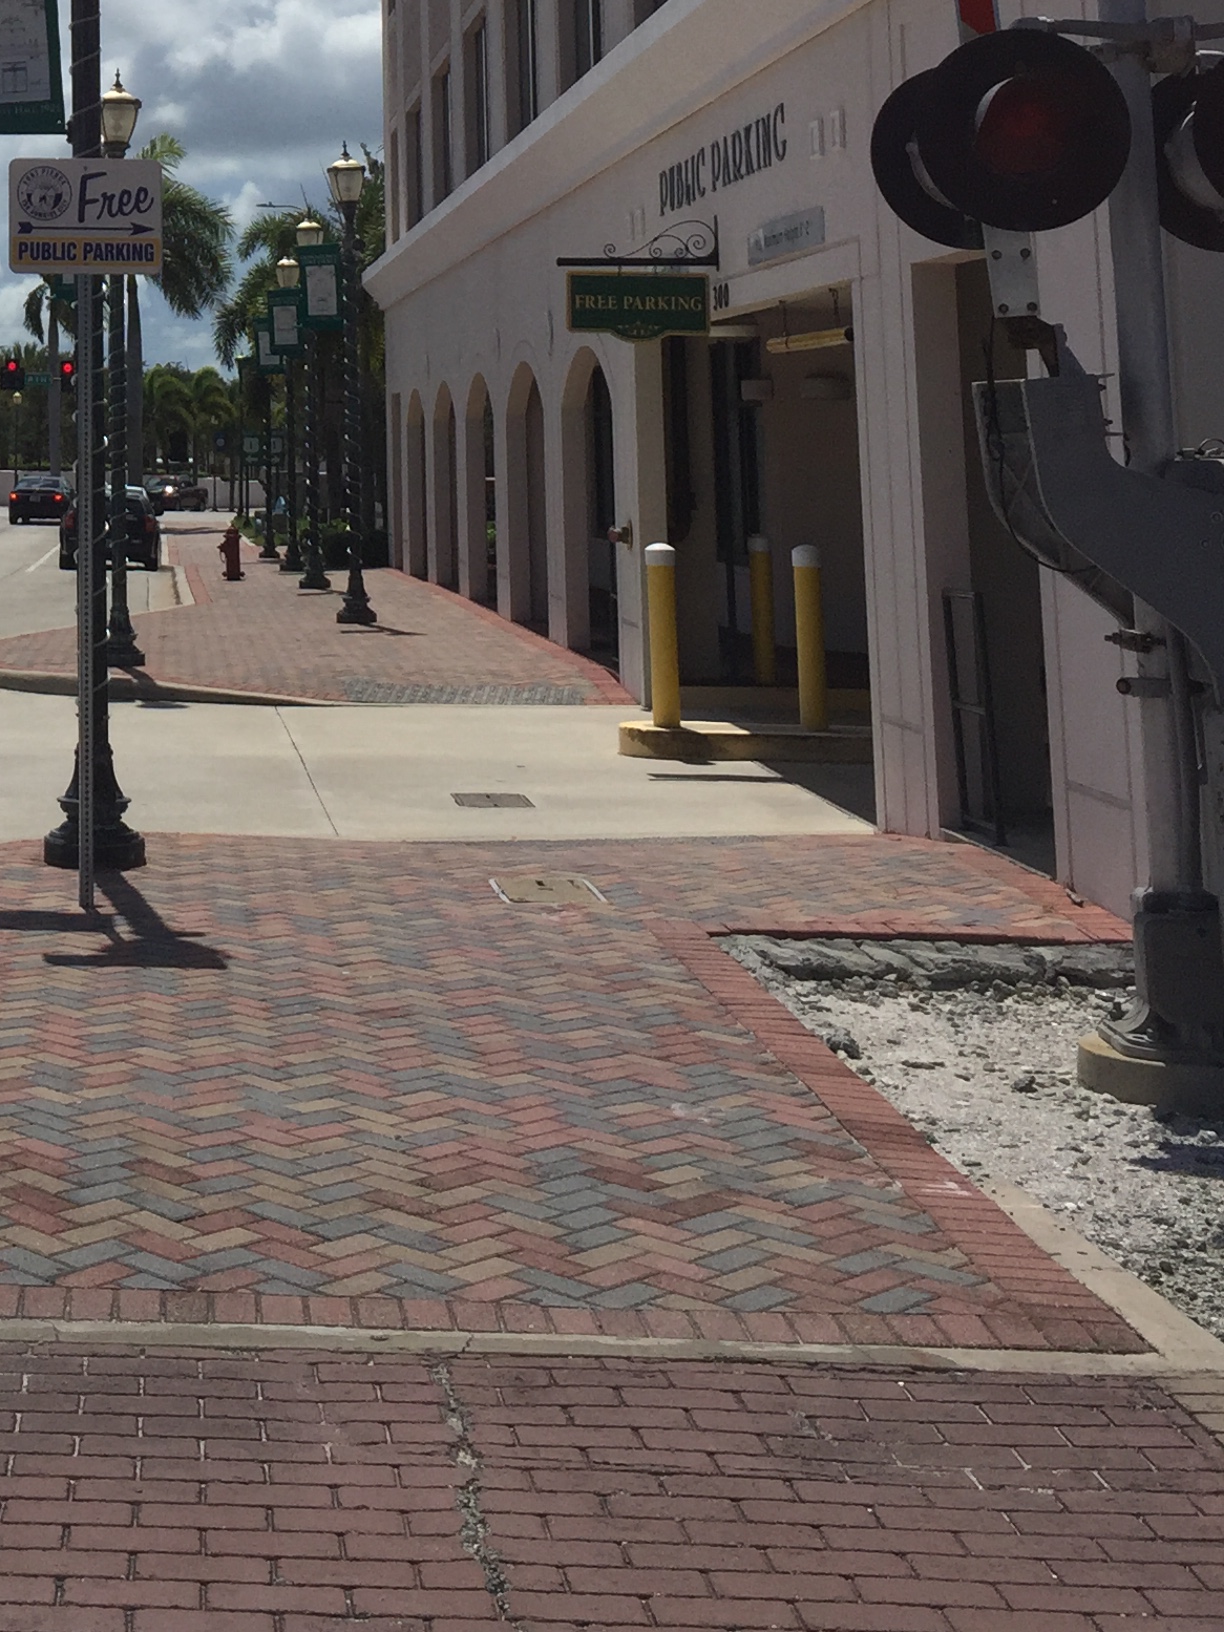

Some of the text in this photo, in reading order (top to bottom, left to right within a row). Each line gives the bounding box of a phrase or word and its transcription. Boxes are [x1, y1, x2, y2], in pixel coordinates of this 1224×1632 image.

[659, 102, 787, 216] PUBLIC PARKING
[77, 170, 154, 223] Free
[18, 241, 155, 262] PUBLIC PARKING
[575, 294, 702, 312] FREE PARKING
[712, 282, 729, 311] 300
